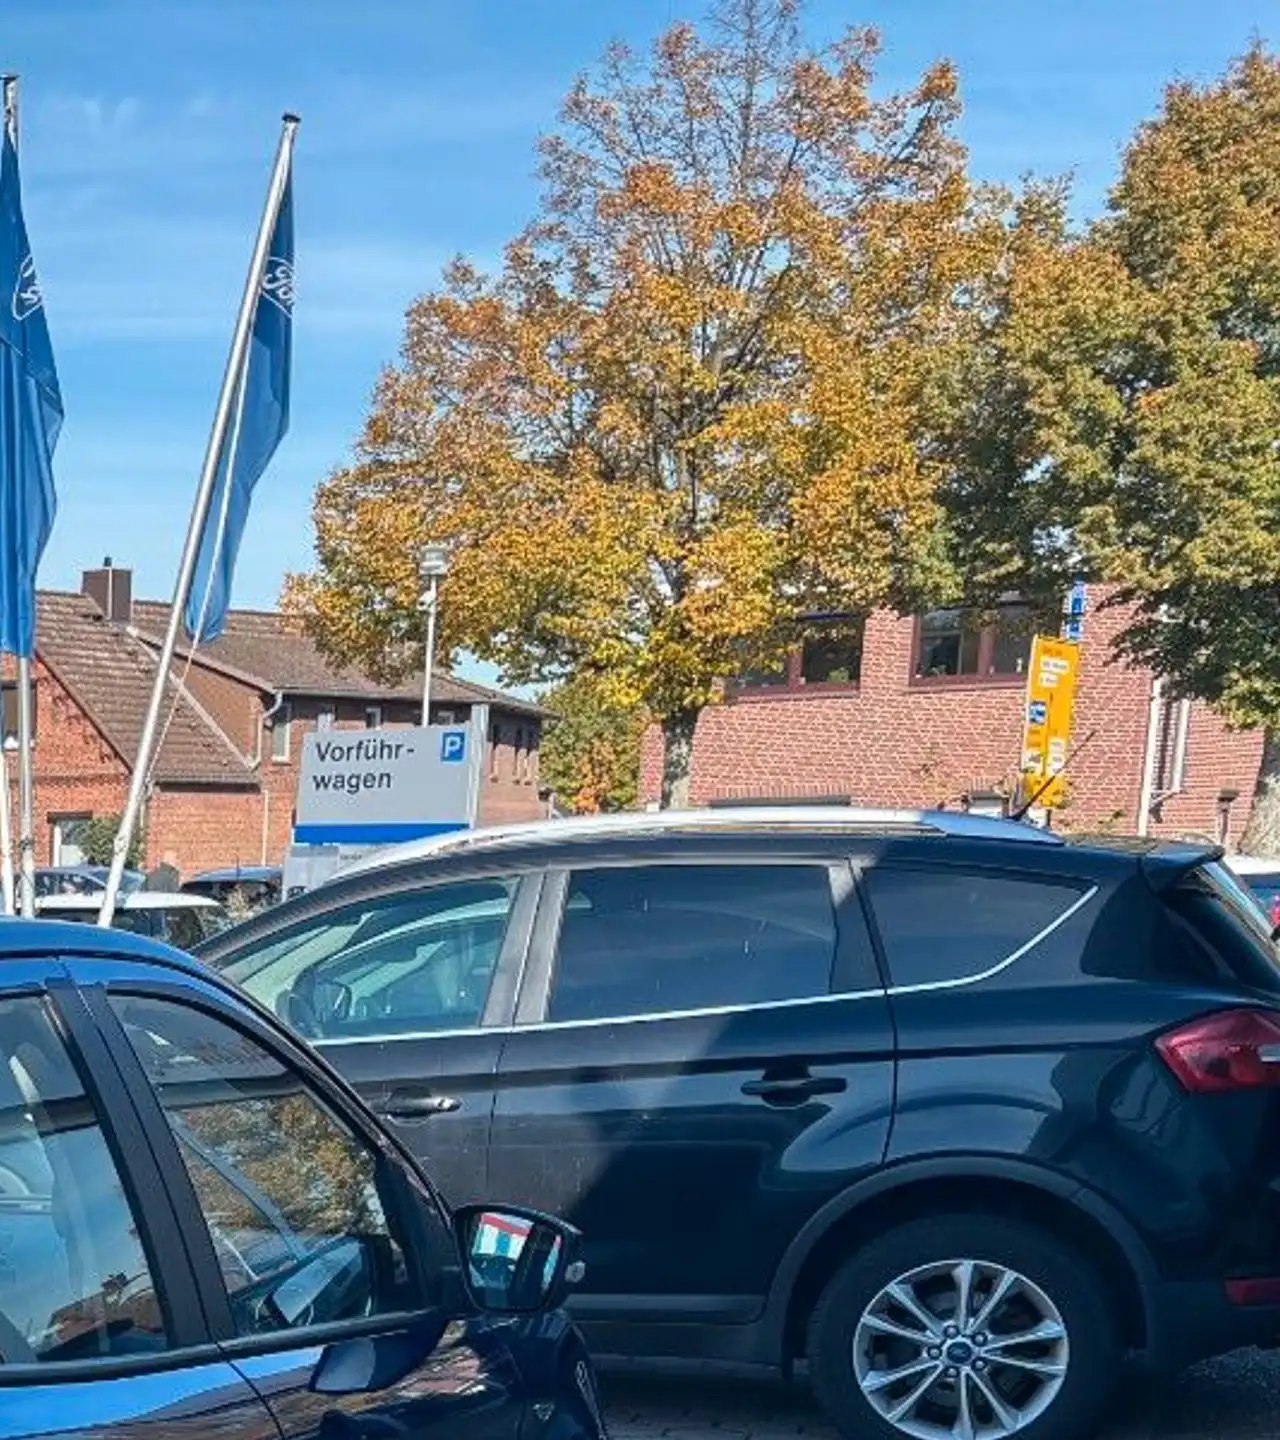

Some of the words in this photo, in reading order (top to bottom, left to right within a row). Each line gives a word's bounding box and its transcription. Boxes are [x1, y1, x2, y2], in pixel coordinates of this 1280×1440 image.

[315, 738, 415, 763] Vorführ-
[444, 736, 461, 758] P
[312, 771, 392, 795] wagen
